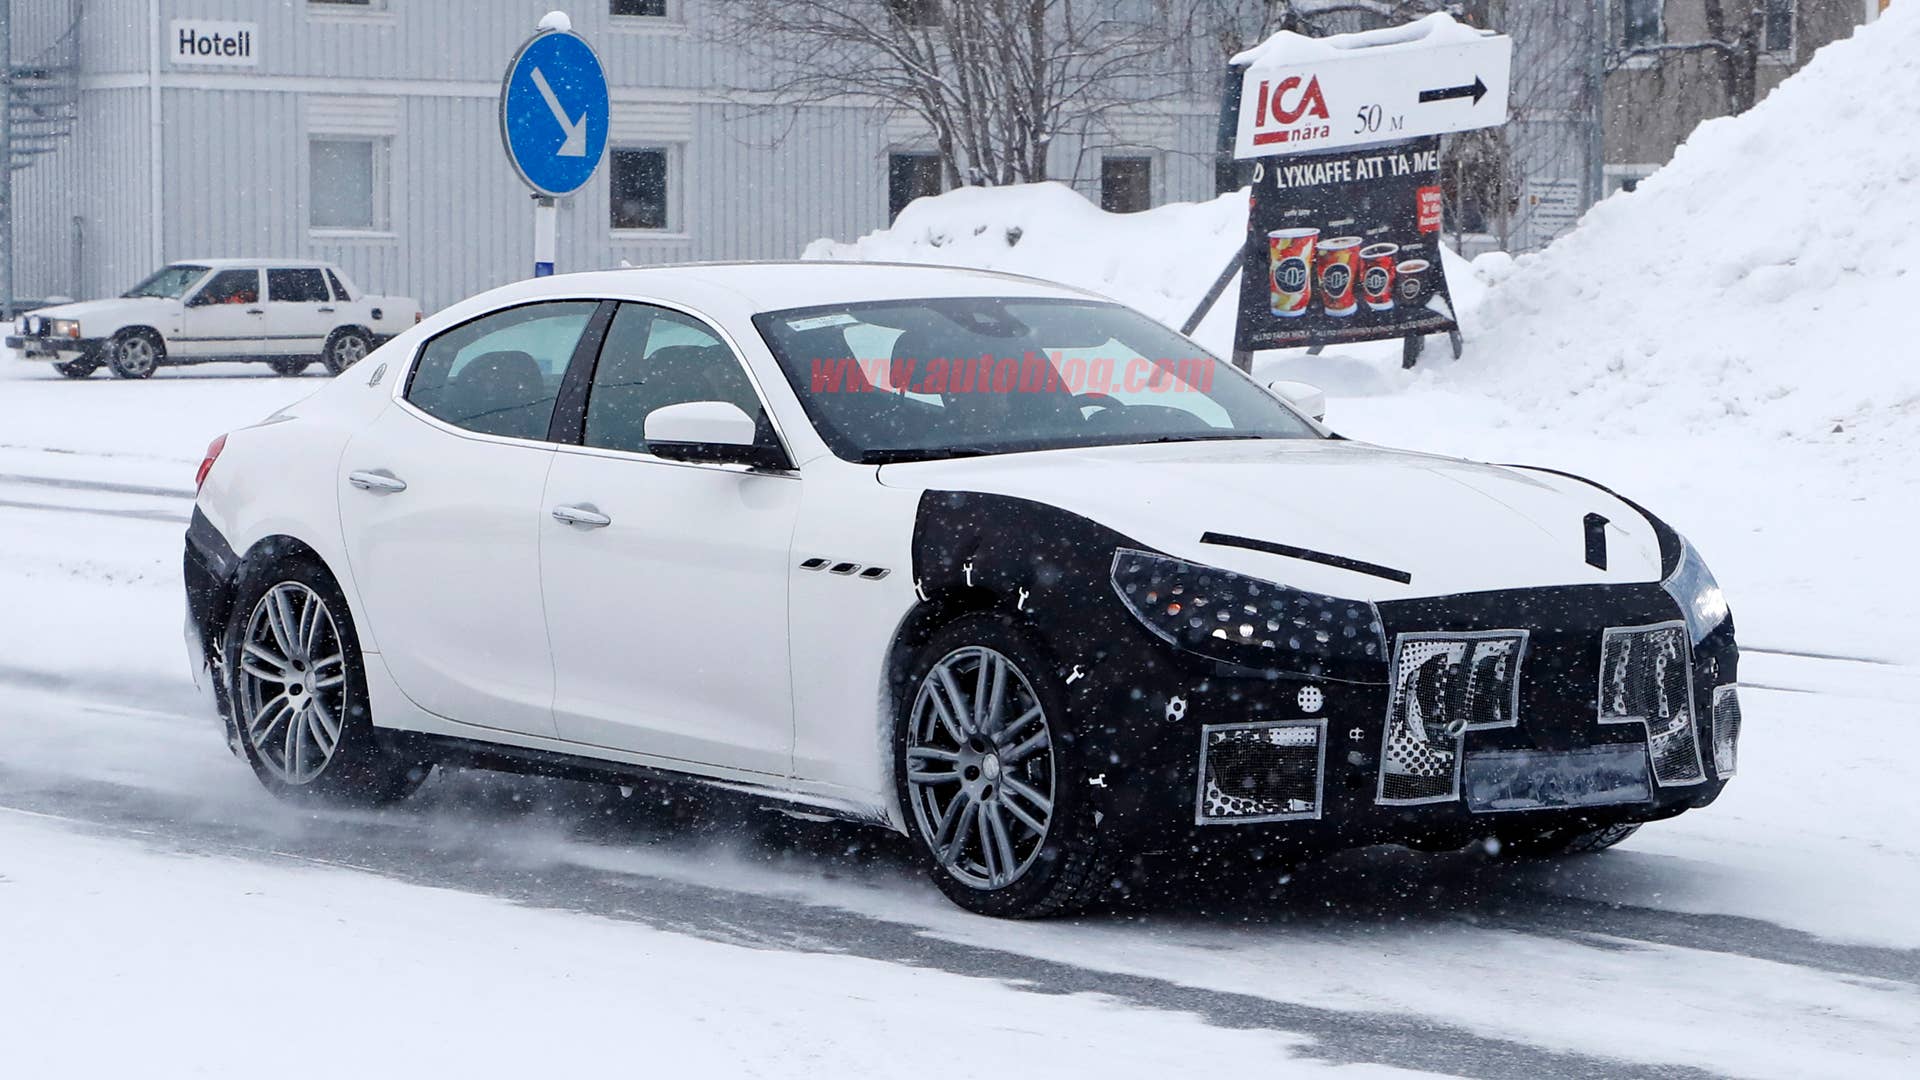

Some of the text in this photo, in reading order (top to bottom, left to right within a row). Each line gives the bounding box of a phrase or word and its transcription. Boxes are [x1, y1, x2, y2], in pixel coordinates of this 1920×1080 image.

[179, 28, 250, 57] Hotell
[1255, 74, 1330, 128] ICA
[1291, 122, 1330, 143] nära
[1354, 103, 1383, 135] 50
[1276, 160, 1353, 189] LYXKAFFE
[1355, 155, 1385, 181] ATT
[1388, 153, 1410, 176] TA
